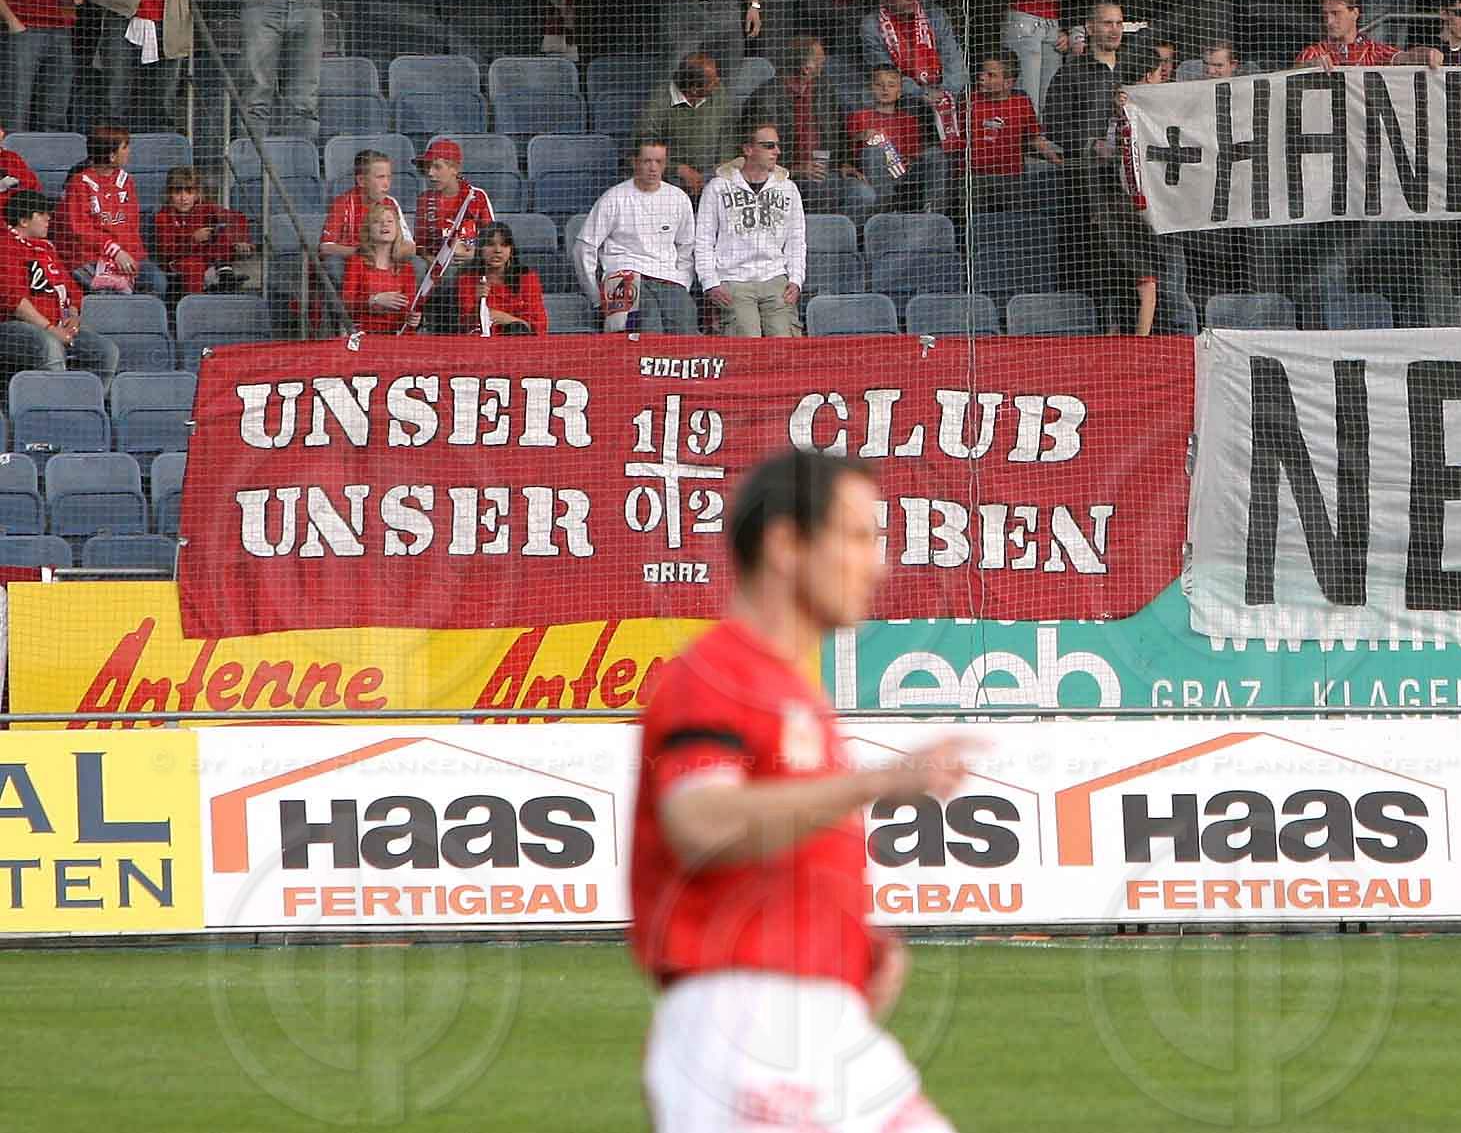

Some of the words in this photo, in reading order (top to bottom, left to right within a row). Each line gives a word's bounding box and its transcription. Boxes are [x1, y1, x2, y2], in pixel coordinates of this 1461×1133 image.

[639, 357, 726, 380] SOCIETY
[236, 375, 593, 449] UNSER
[787, 388, 1088, 463] CLUB
[236, 484, 594, 559] UNSER
[874, 497, 1114, 574] BEN
[643, 562, 710, 582] GRAZ
[66, 617, 389, 730] Antenne
[278, 794, 596, 870] Haas
[867, 794, 1021, 869] as
[1121, 788, 1429, 864] Haas
[282, 884, 599, 917] FERTIGBAU
[1126, 877, 1432, 910] FERTIGBAU
